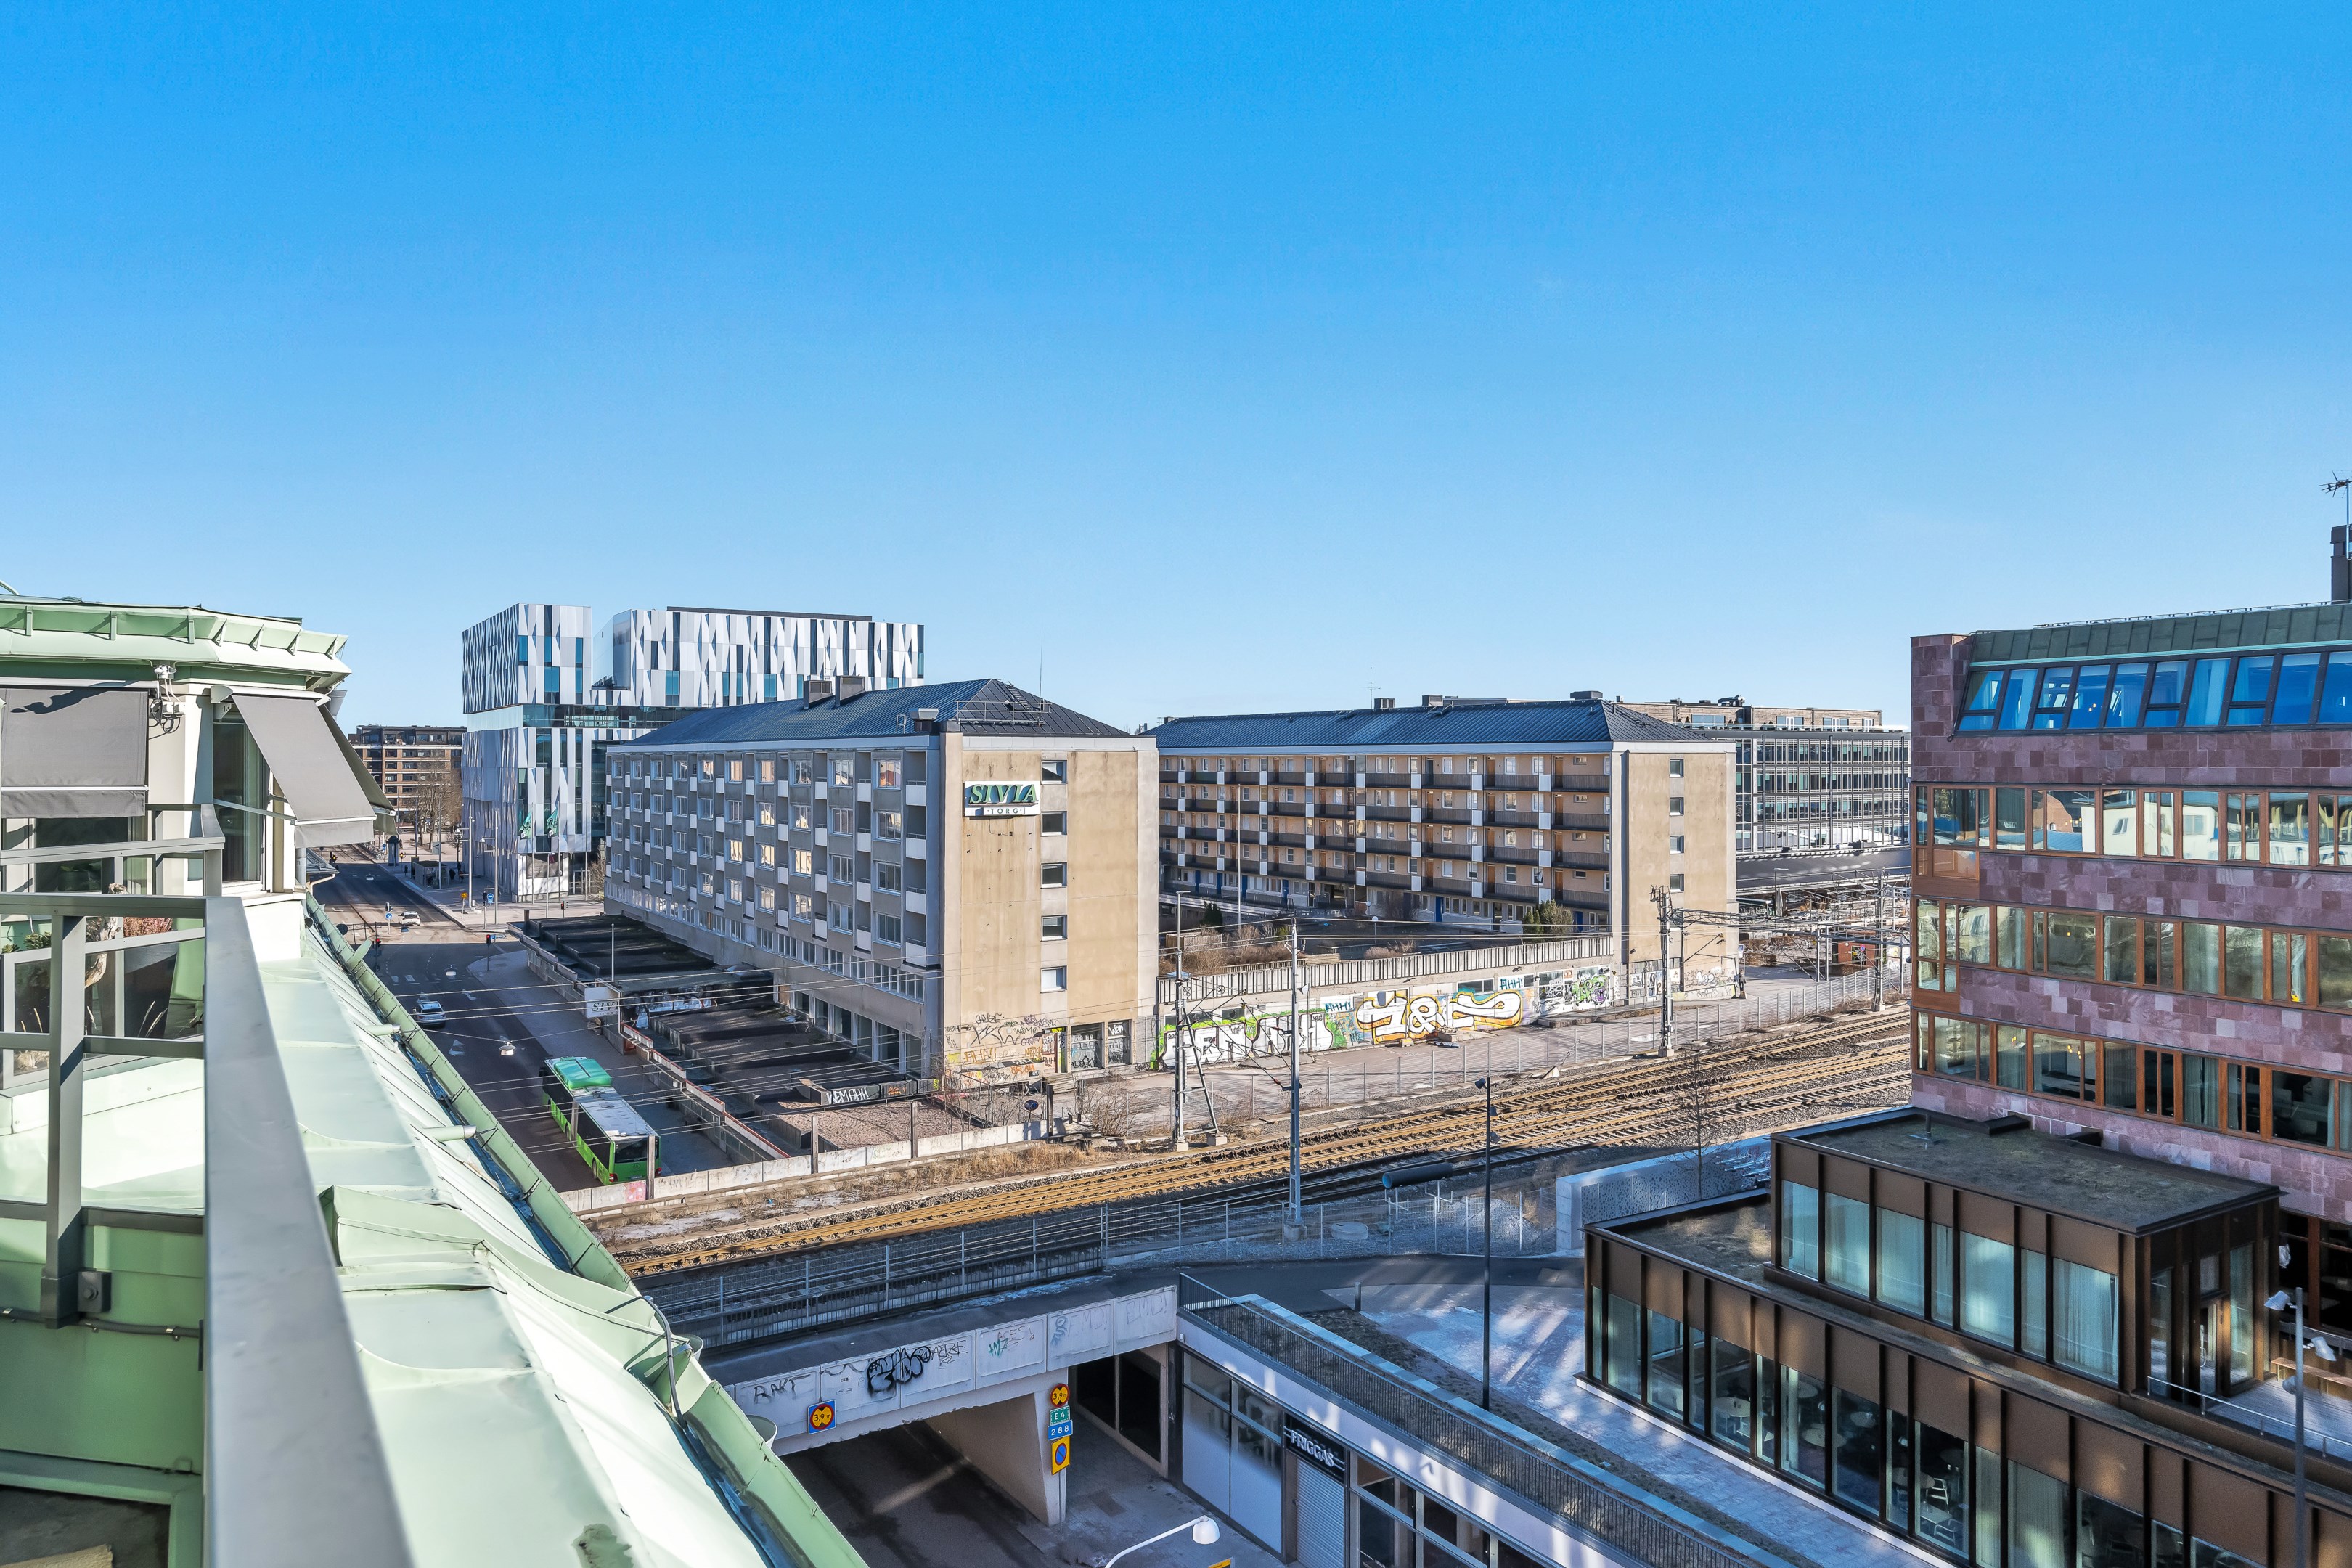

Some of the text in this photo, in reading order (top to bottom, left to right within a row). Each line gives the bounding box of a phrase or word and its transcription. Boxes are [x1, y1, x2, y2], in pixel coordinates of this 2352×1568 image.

[969, 784, 1038, 804] SIVIA
[814, 1413, 825, 1422] 3,9
[1051, 1425, 1069, 1436] 288
[1290, 1429, 1335, 1467] FRIGGAS
